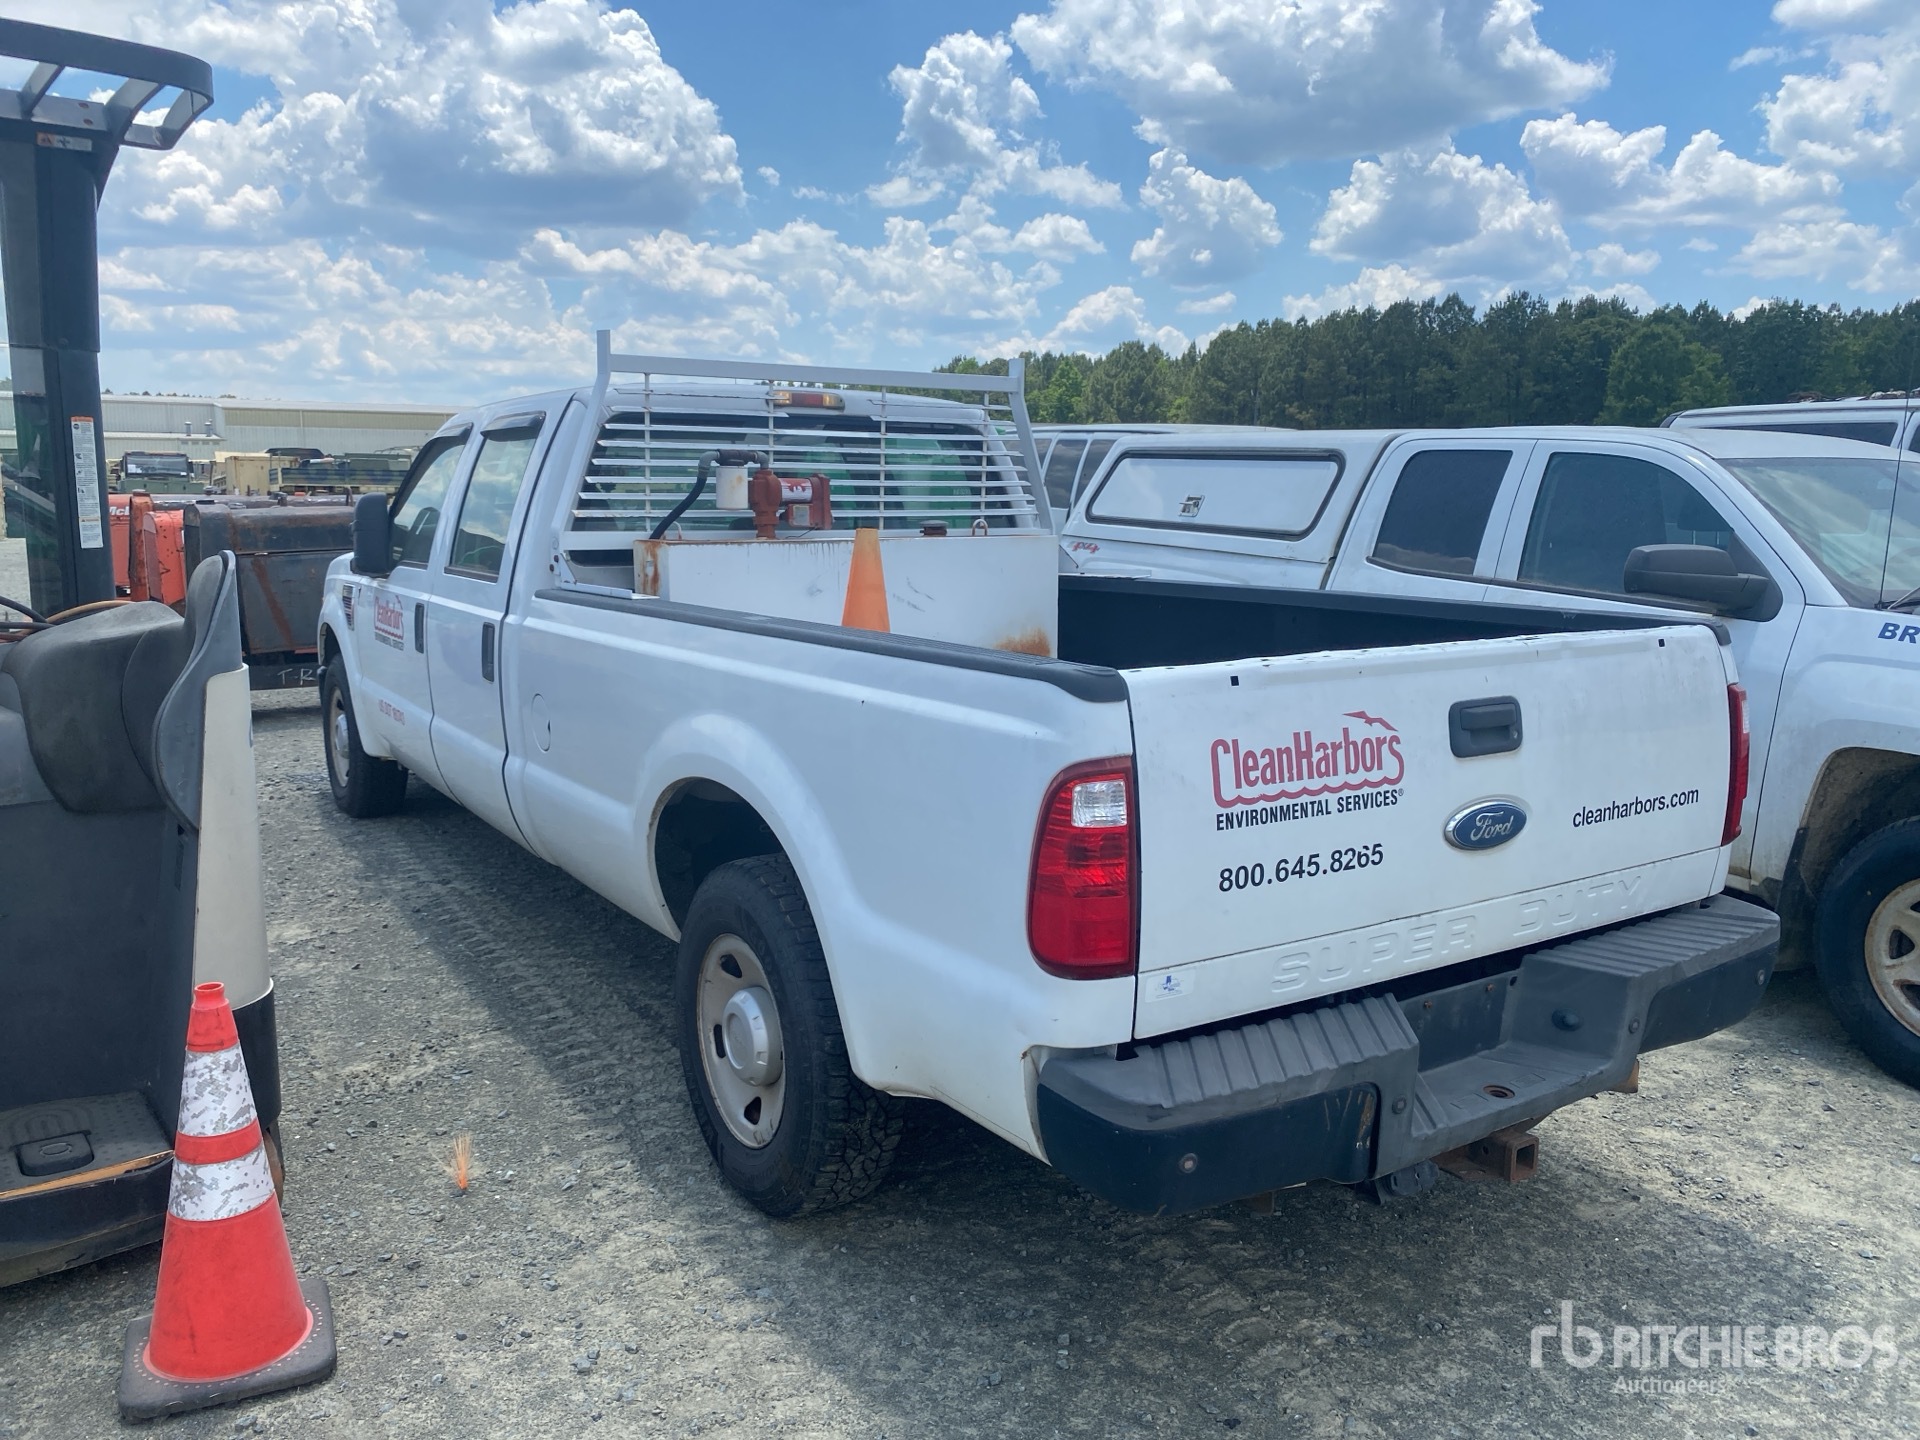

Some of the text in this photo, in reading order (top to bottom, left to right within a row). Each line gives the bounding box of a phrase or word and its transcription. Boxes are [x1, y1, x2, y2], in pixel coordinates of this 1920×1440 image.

[1877, 622, 1920, 644] BR
[1210, 727, 1405, 809] CleanHarbors
[1216, 799, 1332, 831] ENVIRONMENTAL
[1470, 811, 1514, 841] Ford
[1572, 788, 1700, 828] cleanharbors.com
[1218, 843, 1384, 892] 800.645.8265
[1271, 874, 1642, 993] SUPER DUTY
